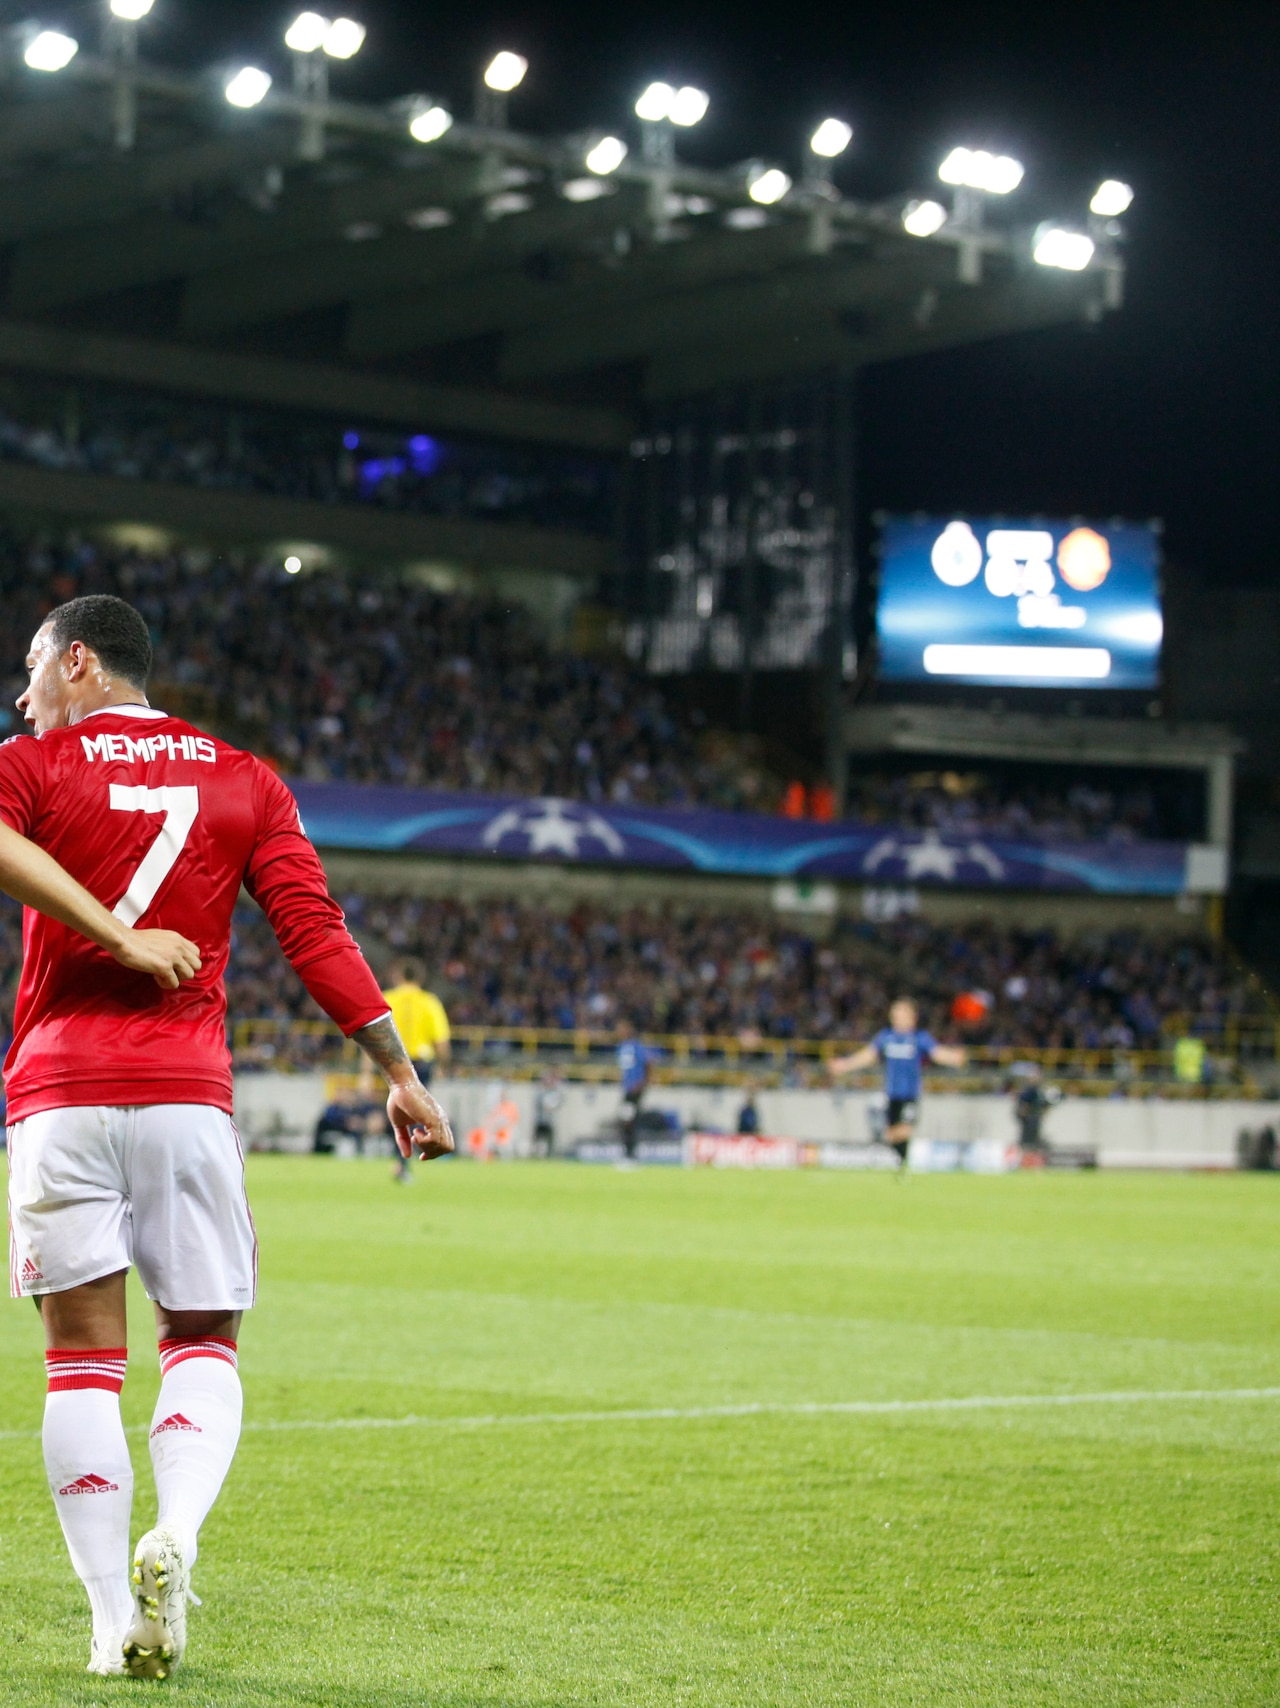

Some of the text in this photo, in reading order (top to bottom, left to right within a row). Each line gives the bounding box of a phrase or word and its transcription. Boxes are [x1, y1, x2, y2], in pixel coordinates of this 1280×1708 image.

[80, 734, 217, 763] MEMPHIS
[109, 783, 200, 929] 7
[150, 1423, 202, 1439] adidas
[59, 1484, 119, 1496] adidas
